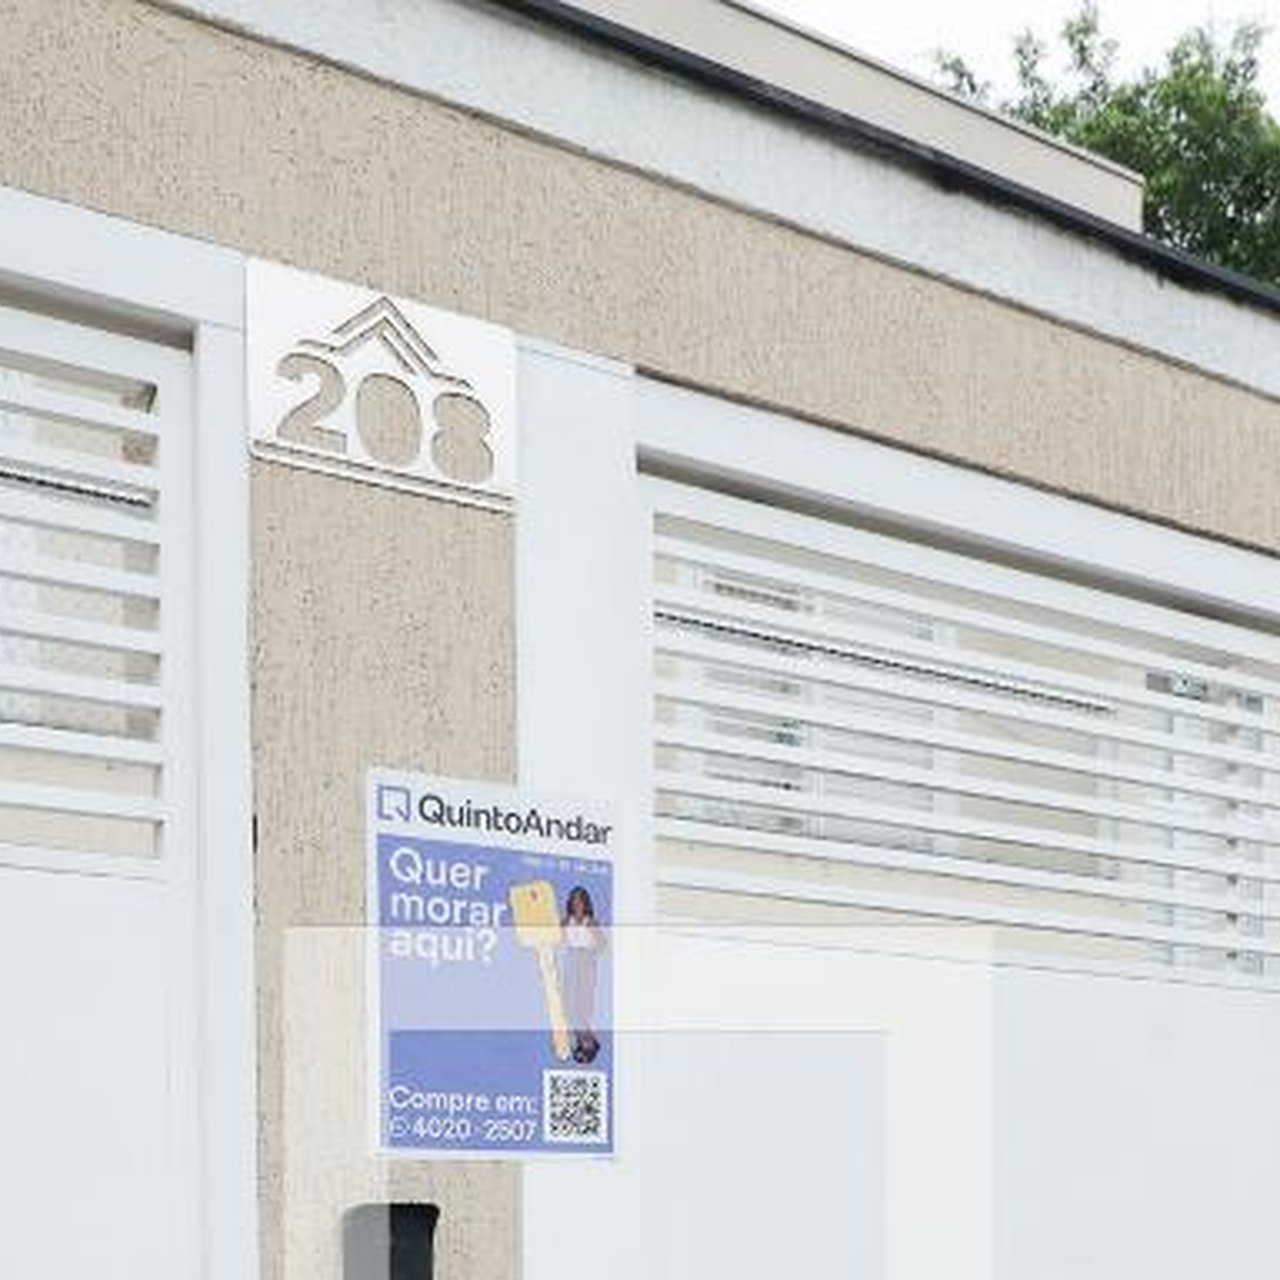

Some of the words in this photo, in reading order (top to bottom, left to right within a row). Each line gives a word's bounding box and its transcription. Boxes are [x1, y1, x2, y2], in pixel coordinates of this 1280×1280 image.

[276, 352, 494, 484] 208
[419, 793, 612, 845] QuintoAndar
[390, 846, 489, 890] Quer
[390, 893, 506, 929] morar
[390, 928, 497, 967] aqui?
[389, 1085, 490, 1116] Compre
